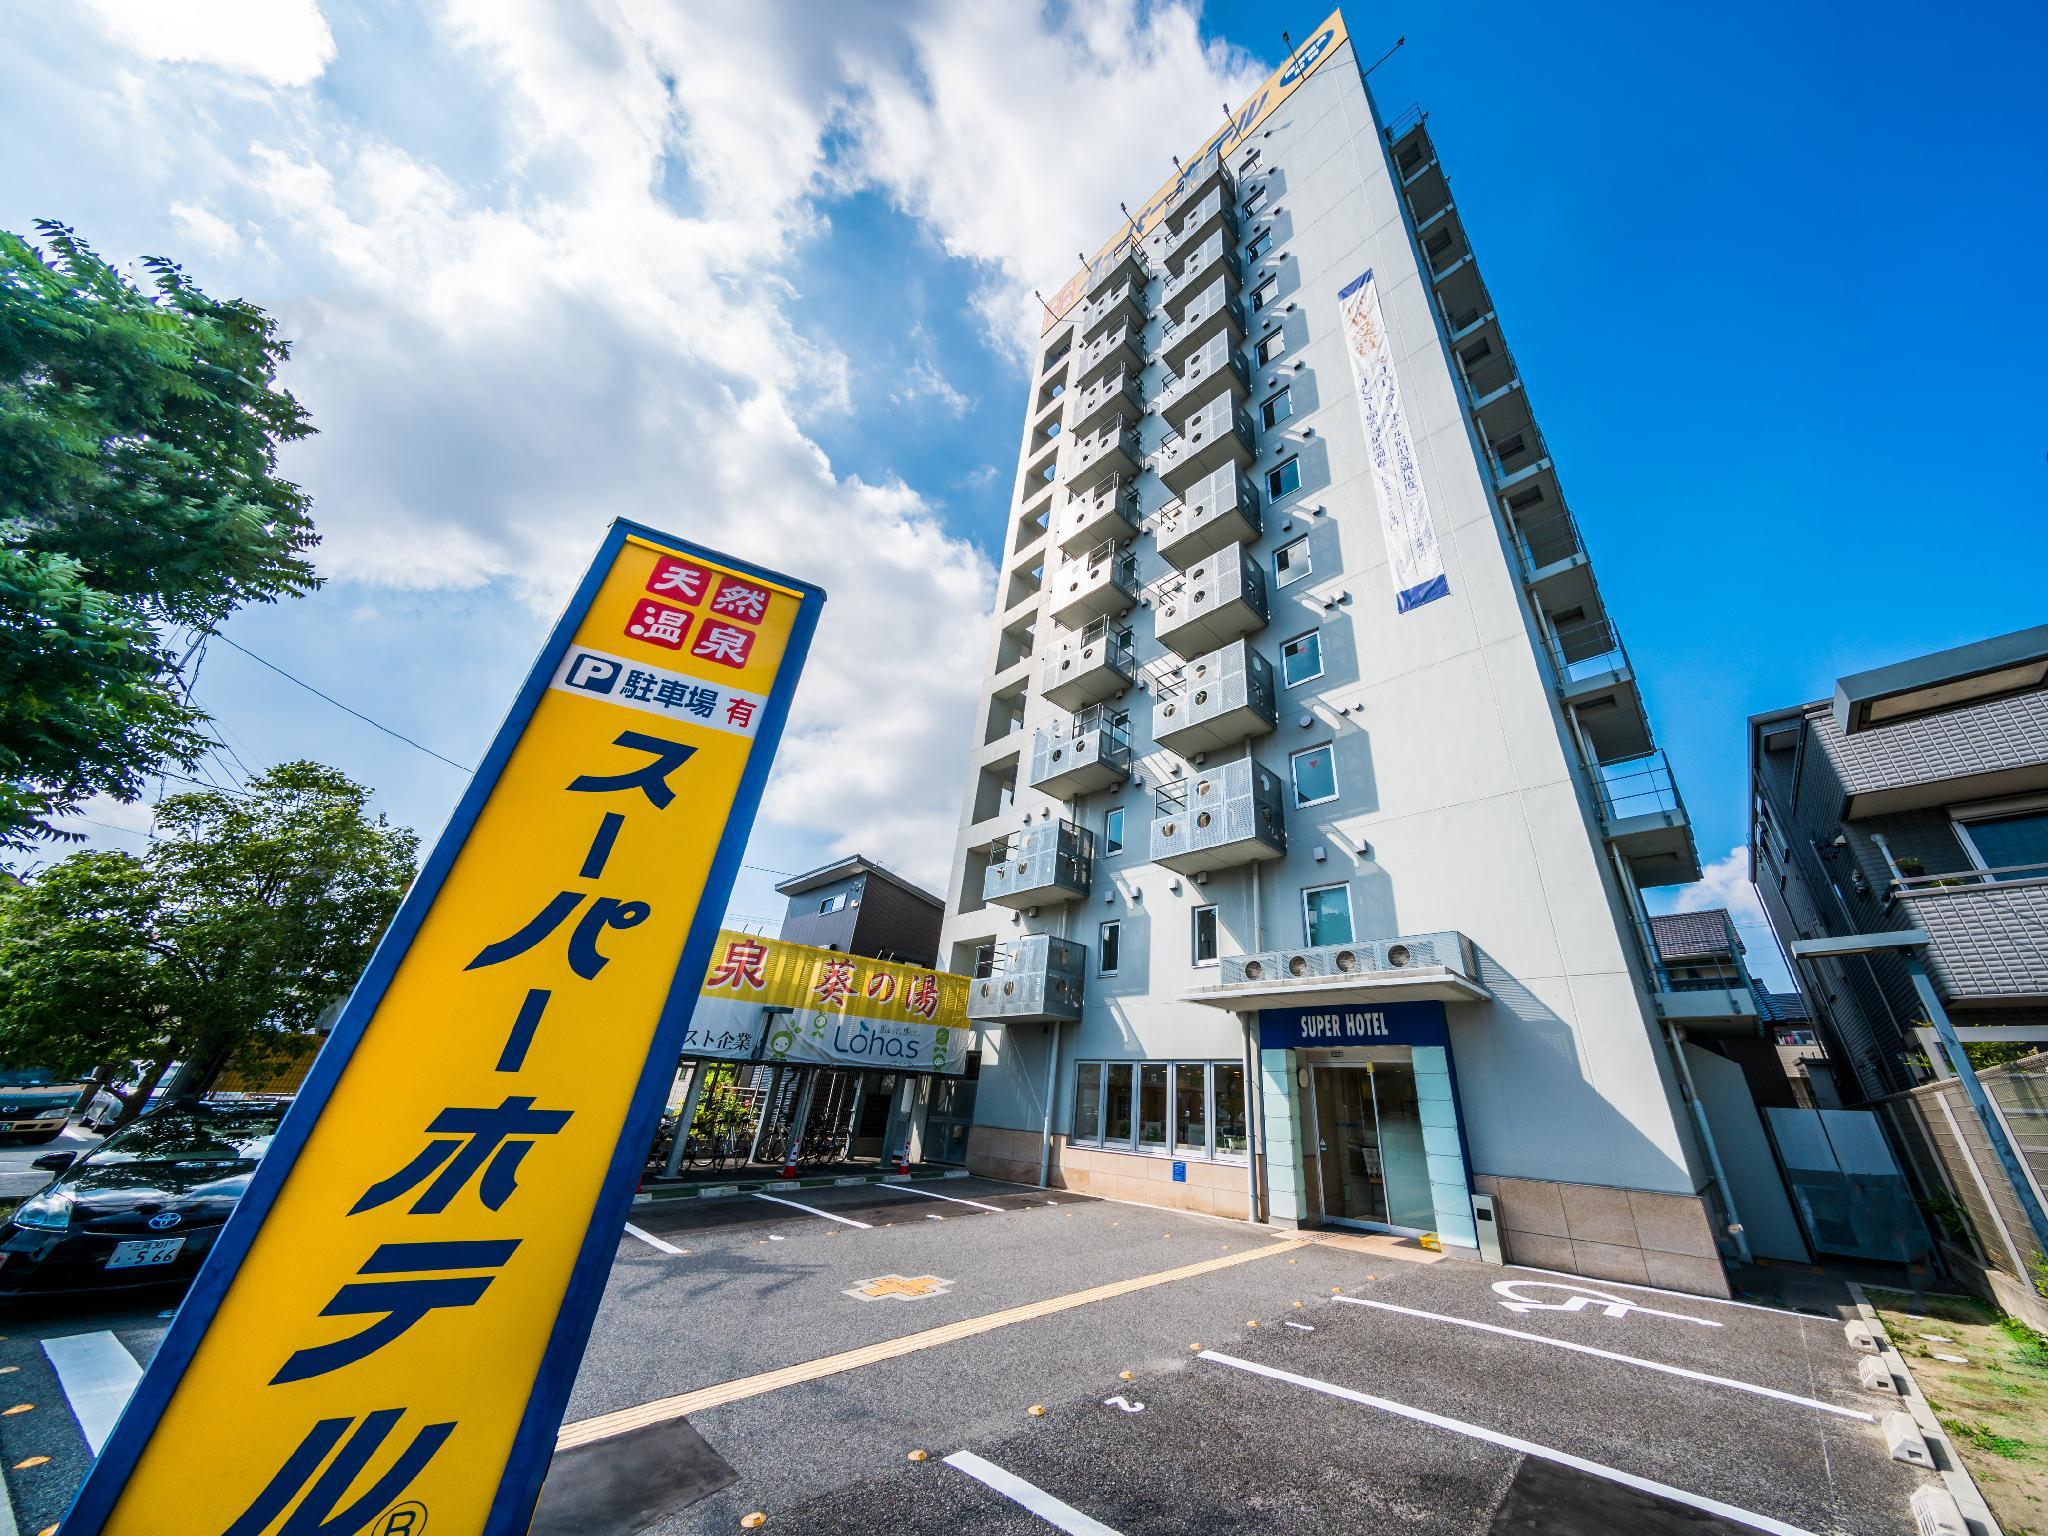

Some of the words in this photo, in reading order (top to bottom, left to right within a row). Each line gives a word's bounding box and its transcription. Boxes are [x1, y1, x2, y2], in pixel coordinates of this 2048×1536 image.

[653, 565, 764, 618] 天然
[630, 606, 747, 663] 温泉
[619, 669, 719, 719] 駐車場
[725, 697, 758, 729] 有
[706, 939, 768, 990] 泉
[813, 958, 940, 1019] 葵の湯
[834, 1024, 919, 1059] Lohas
[1301, 1015, 1342, 1038] SUPER
[1345, 1012, 1389, 1037] HOTEL
[218, 730, 698, 1536] スーパーホテル
